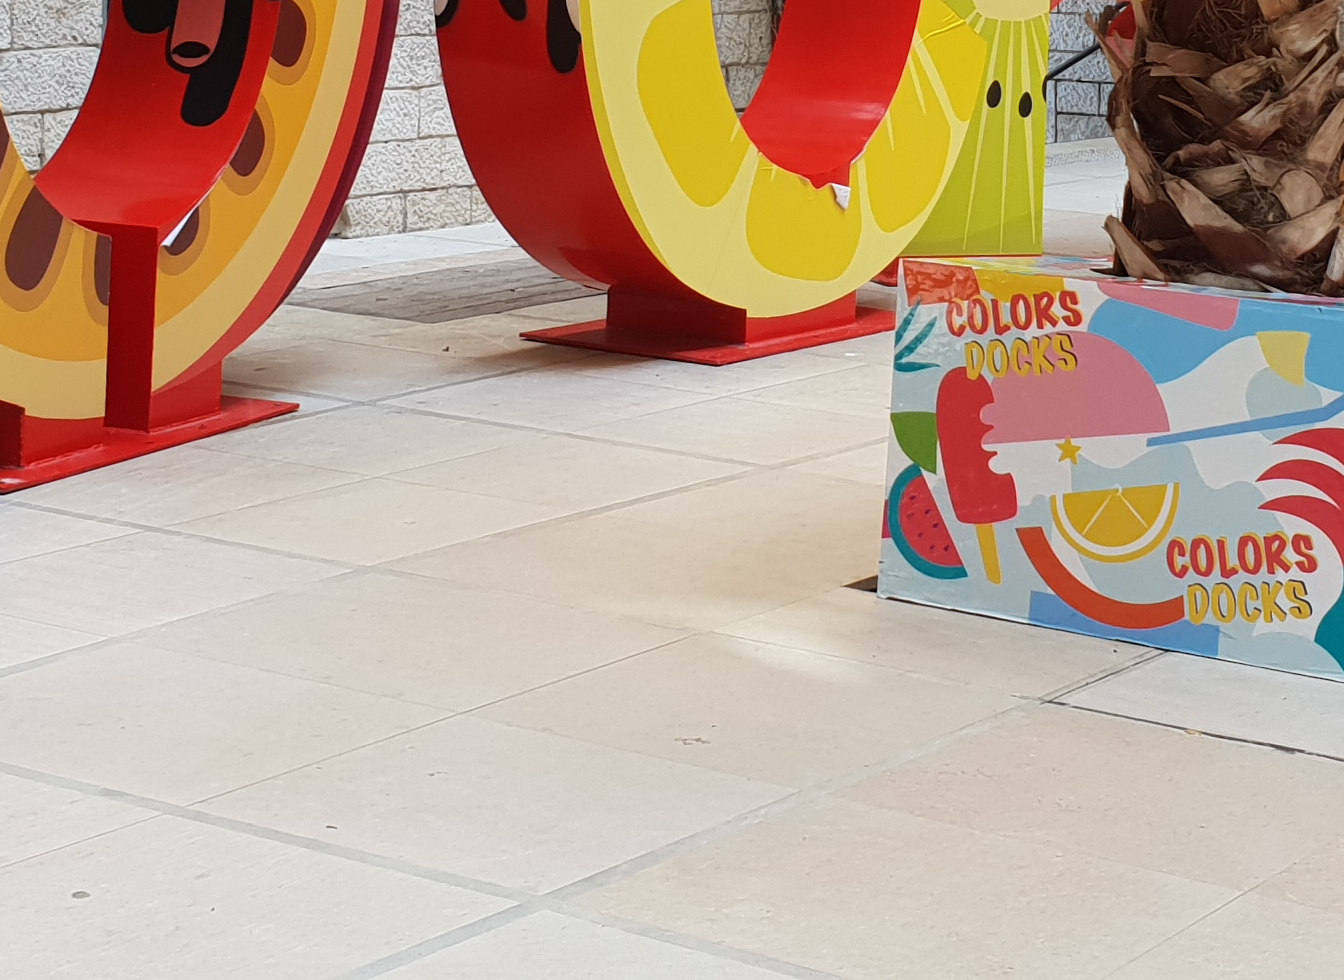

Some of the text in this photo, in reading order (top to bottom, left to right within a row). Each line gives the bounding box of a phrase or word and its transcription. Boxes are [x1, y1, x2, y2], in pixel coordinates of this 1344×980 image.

[946, 290, 1084, 337] COLORS
[964, 333, 1079, 381] DOCKS
[1166, 531, 1320, 579] COLORS
[1187, 579, 1313, 625] DOCKS
